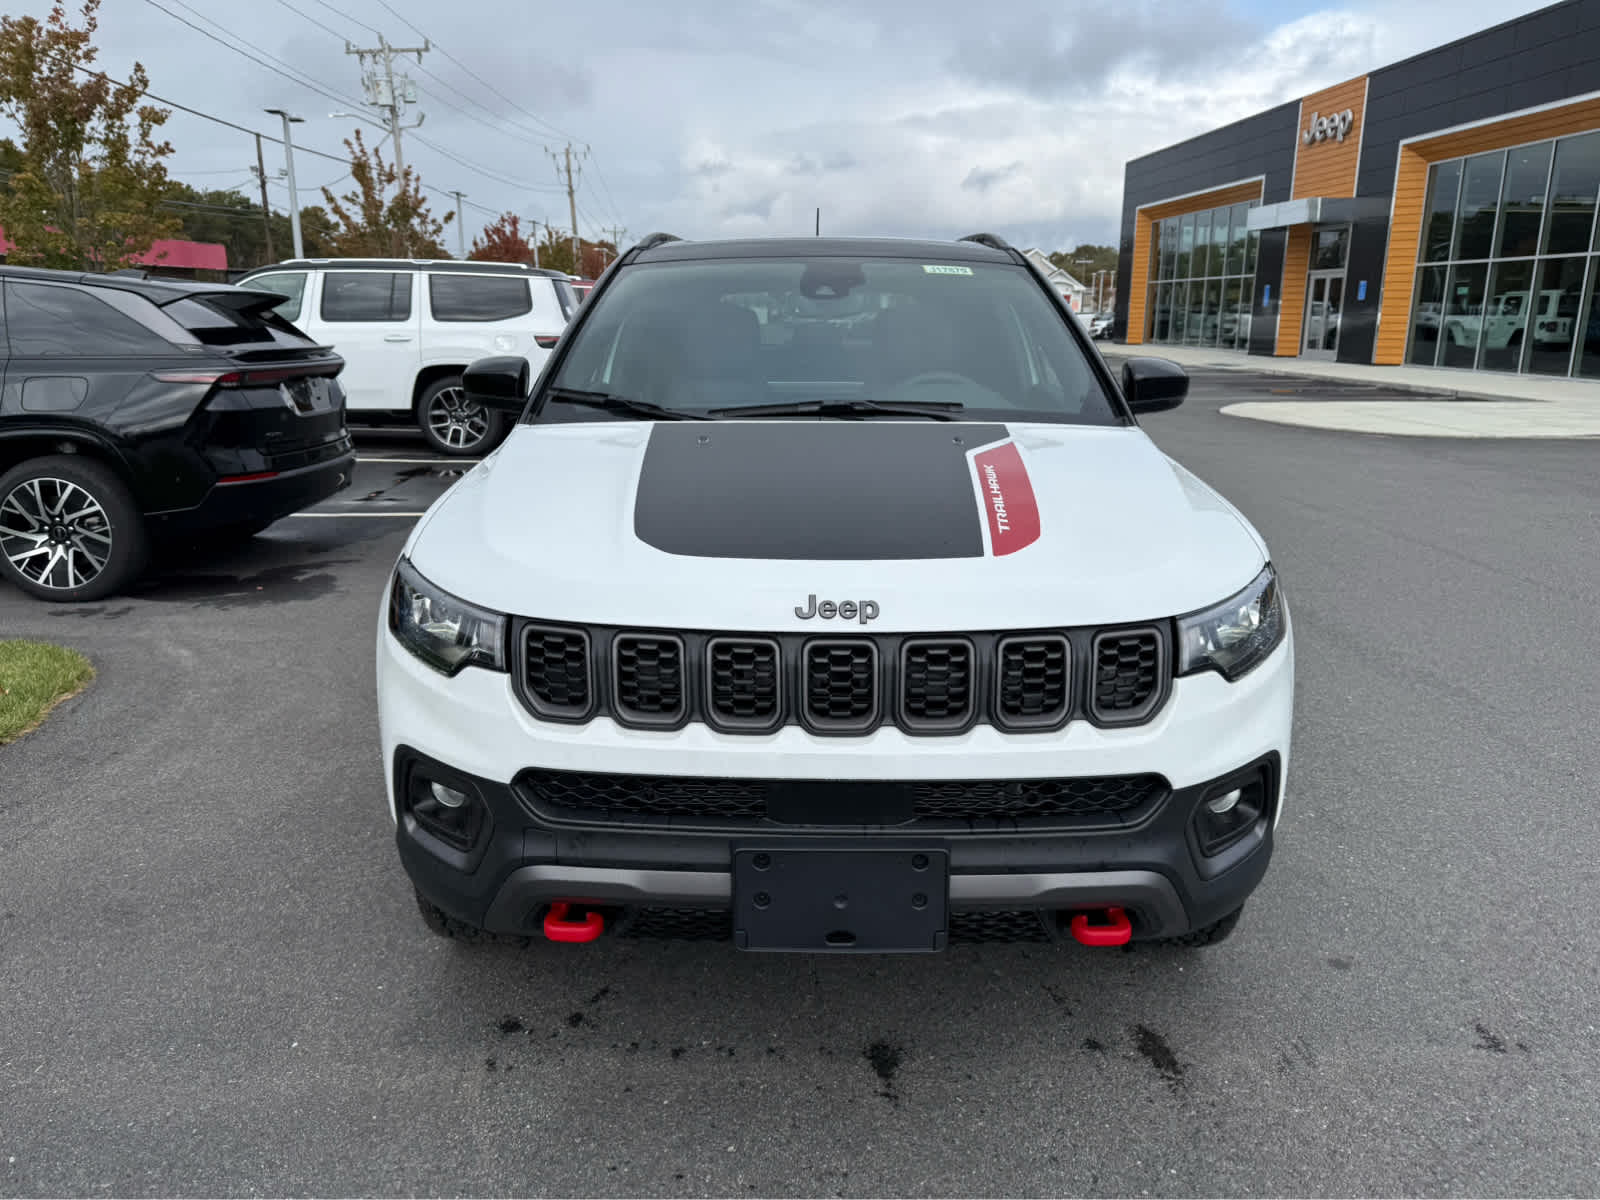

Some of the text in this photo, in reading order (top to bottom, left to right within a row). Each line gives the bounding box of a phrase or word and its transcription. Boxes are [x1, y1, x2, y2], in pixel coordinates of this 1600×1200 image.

[1303, 109, 1353, 144] Jeep
[983, 464, 1010, 534] TRAILHAWK
[794, 594, 880, 624] Jeep
